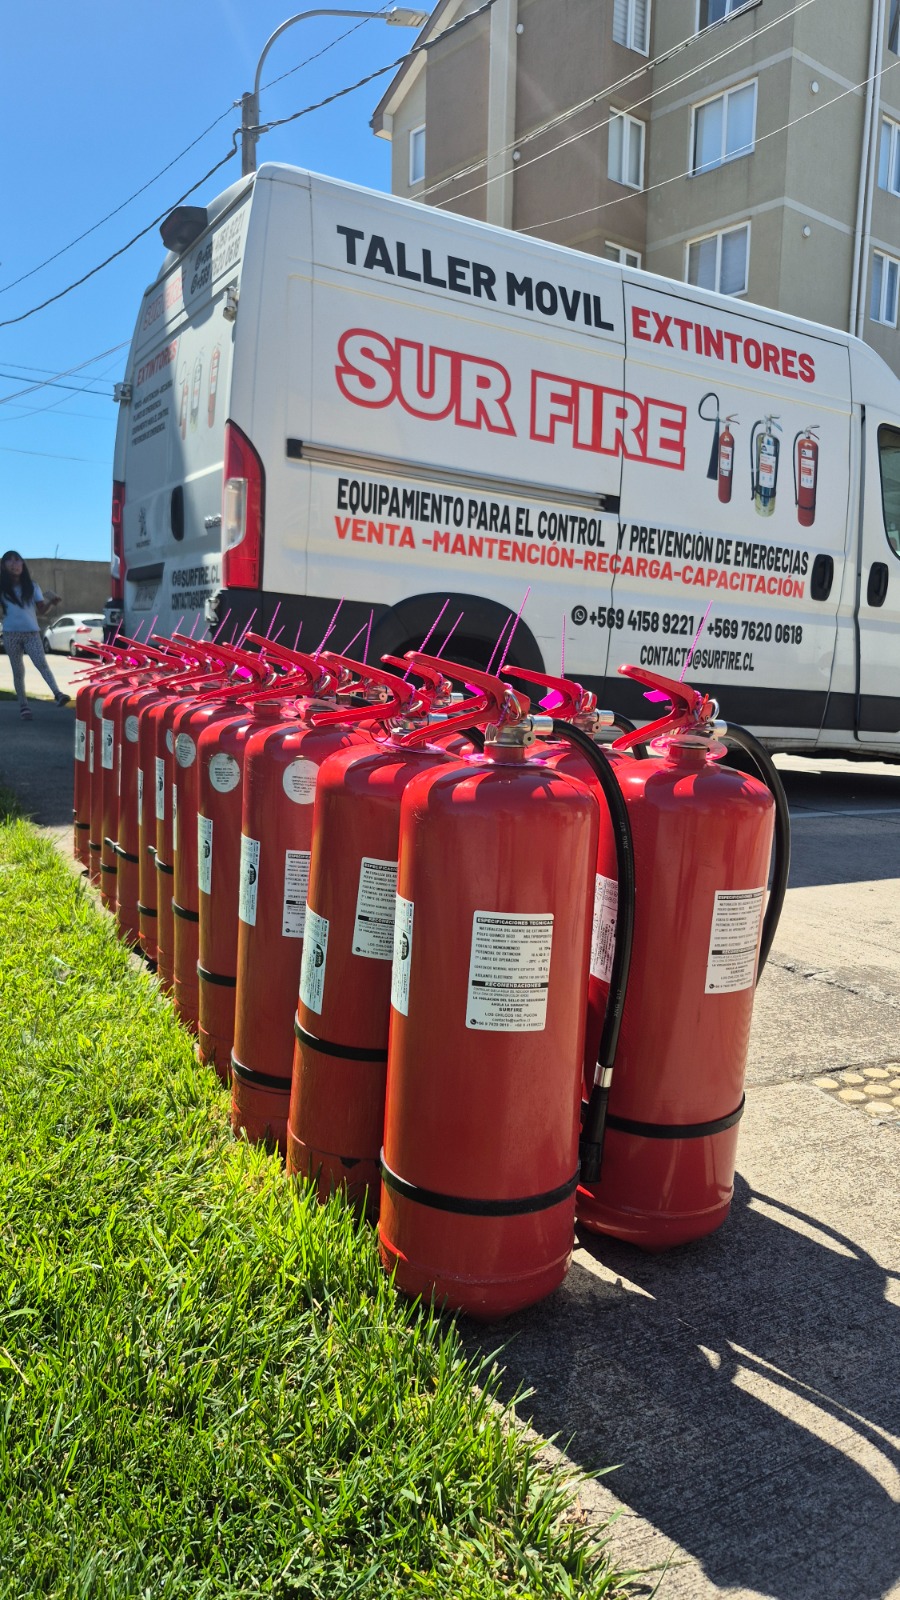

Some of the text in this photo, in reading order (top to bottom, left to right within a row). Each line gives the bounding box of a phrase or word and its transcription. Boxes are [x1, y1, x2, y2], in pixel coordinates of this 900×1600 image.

[336, 224, 816, 383] TALLER MOVIL EXTINTORES
[335, 328, 517, 437] SUR
[530, 369, 687, 471] FIRE
[334, 516, 416, 549] VENTA
[337, 478, 464, 528] EQUIPAMIENTO
[468, 499, 511, 534] PARA
[515, 507, 534, 538] EL
[538, 510, 605, 547] CONTROL
[617, 522, 627, 550] Y
[715, 538, 732, 566] DE
[734, 541, 810, 576] EMERGECIAS
[589, 607, 624, 630] +569
[628, 610, 660, 632] 4158
[662, 614, 694, 636] 9221
[707, 618, 738, 640] +569
[742, 621, 772, 642] 7620
[774, 624, 803, 644] 0618
[640, 645, 754, 672] CONTACTO@SURFIRE.CL
[478, 917, 528, 925] ESPECIFICACIONES
